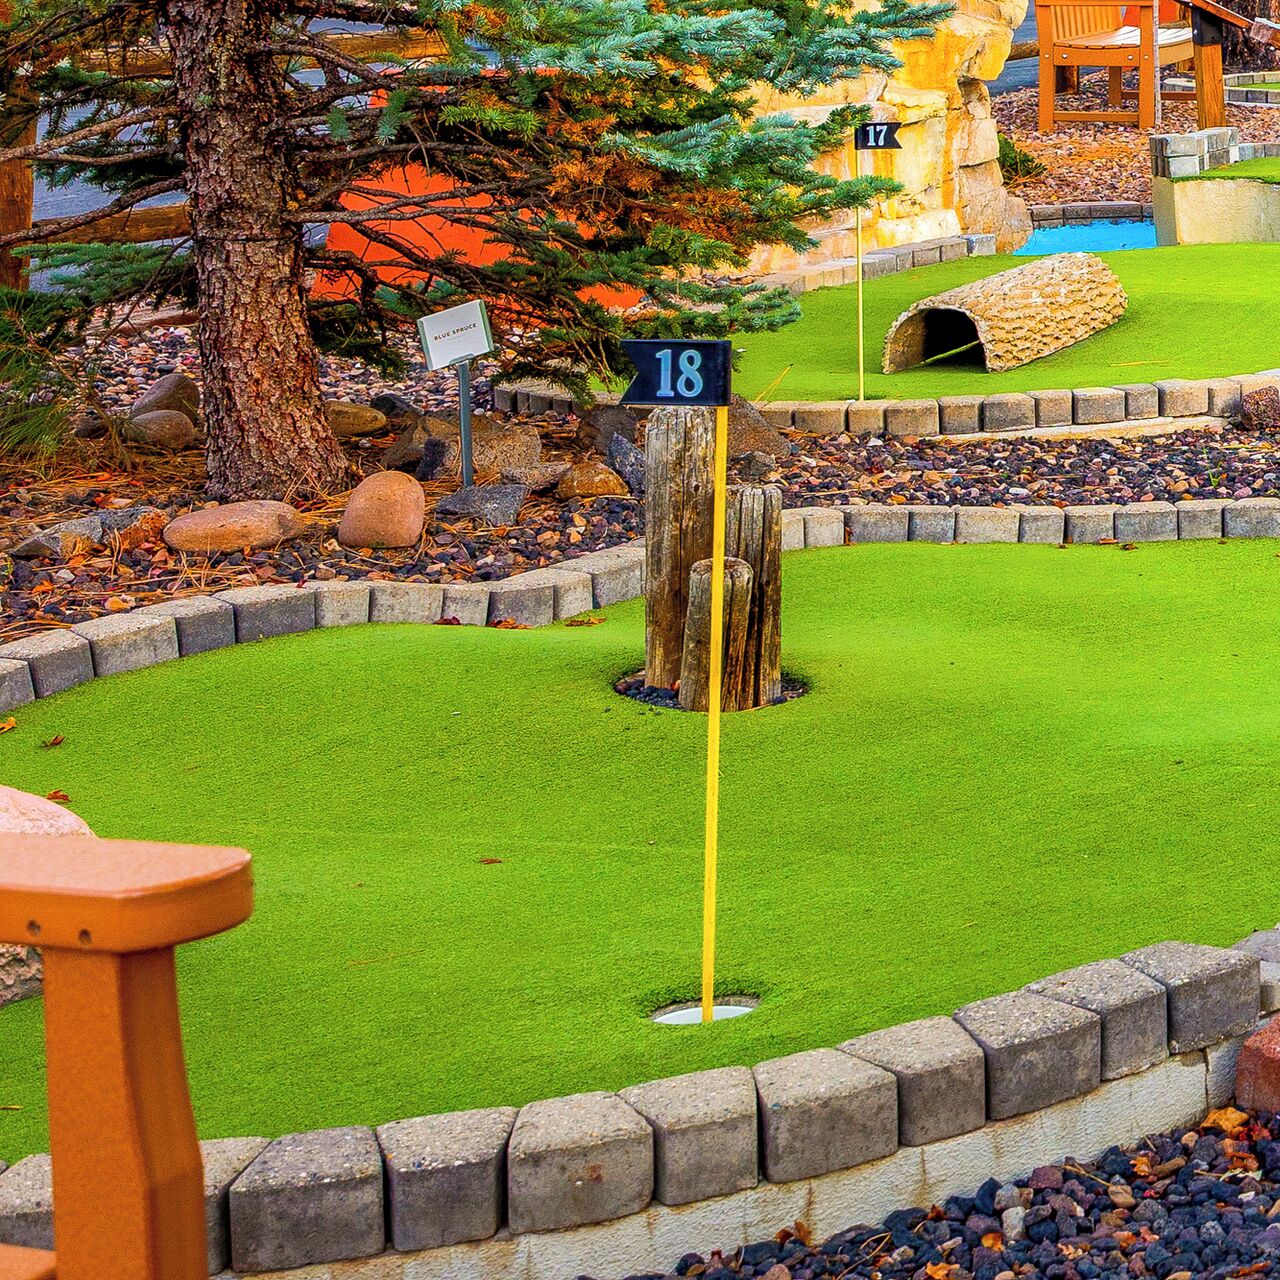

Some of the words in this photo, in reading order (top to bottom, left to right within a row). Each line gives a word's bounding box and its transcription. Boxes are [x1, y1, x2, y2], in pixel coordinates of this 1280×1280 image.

[866, 125, 888, 147] 17
[433, 331, 451, 341] BLUE
[452, 322, 477, 336] SPRUCE
[655, 349, 703, 398] 18
